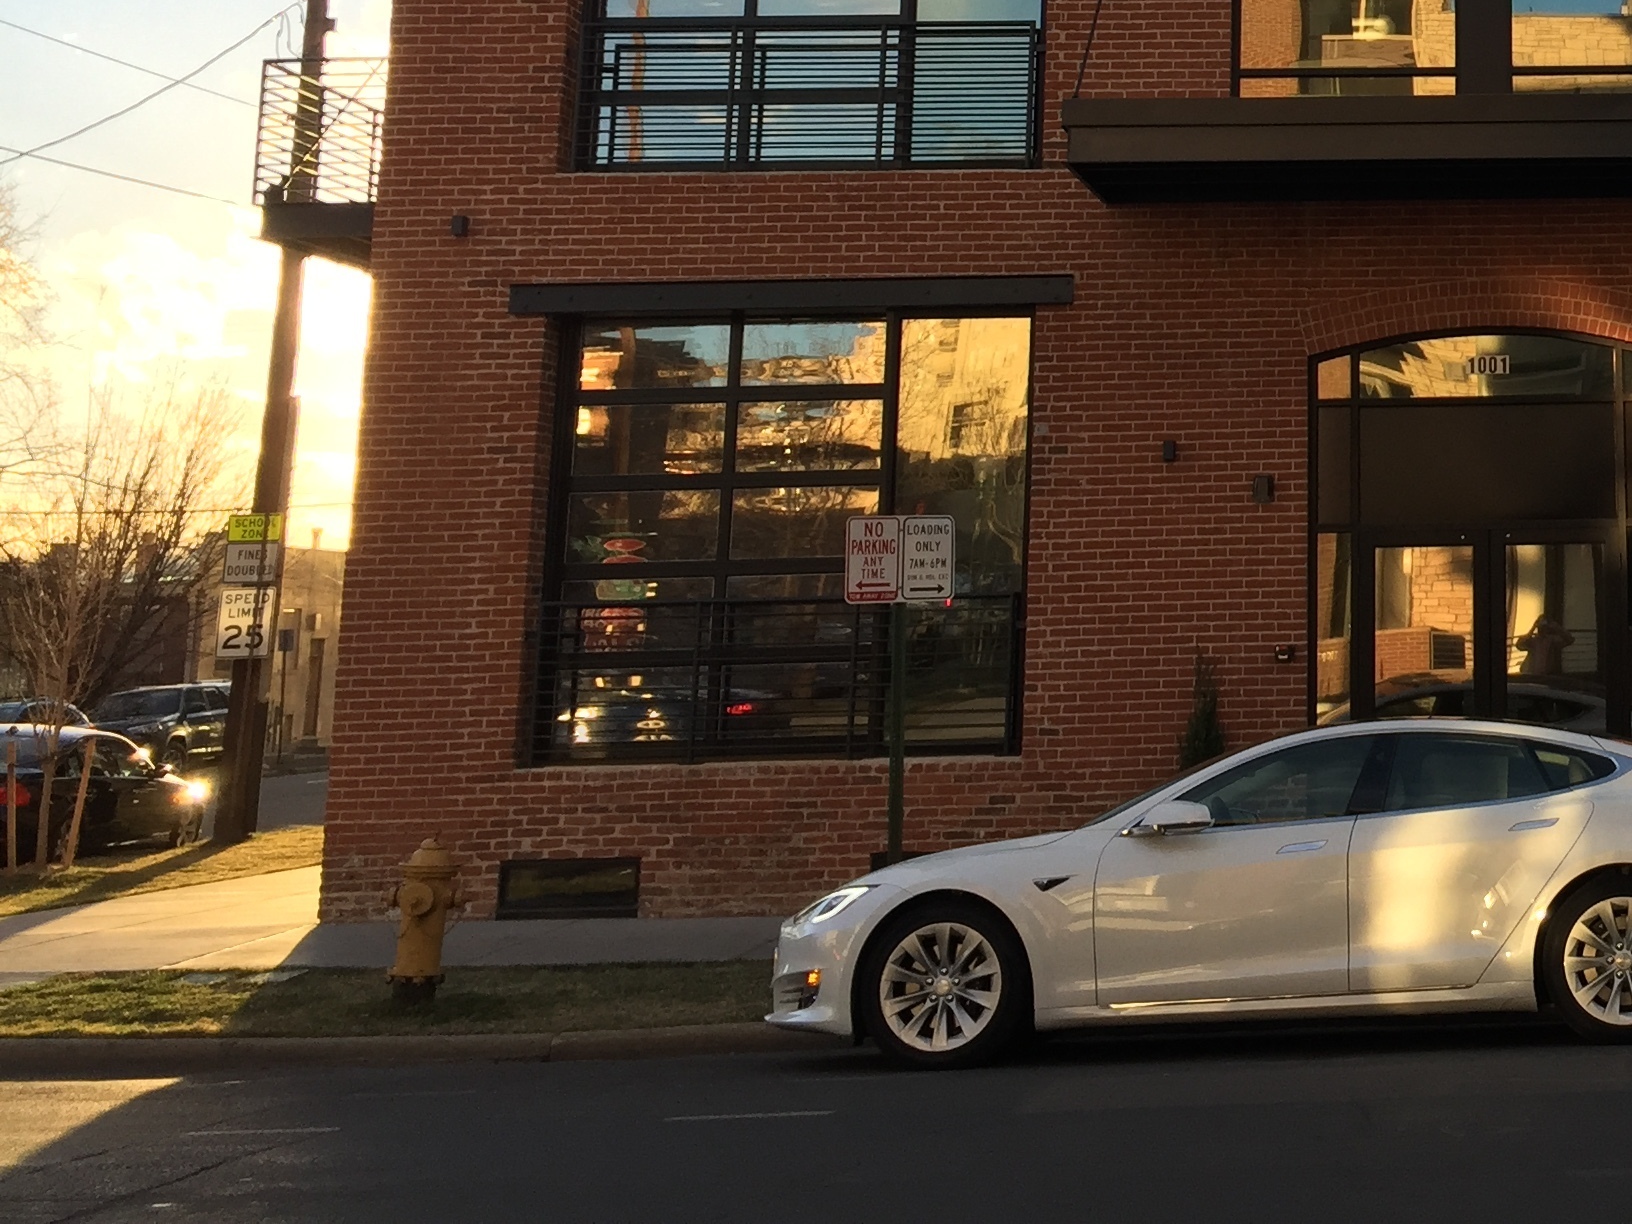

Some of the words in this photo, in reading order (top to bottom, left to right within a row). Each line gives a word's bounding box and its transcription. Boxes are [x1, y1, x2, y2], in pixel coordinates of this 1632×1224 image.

[1468, 356, 1507, 374] 1001
[235, 518, 277, 528] SCHOL
[864, 521, 884, 538] NO
[907, 524, 950, 536] LOADING
[851, 539, 896, 555] PARKING
[915, 541, 941, 552] ONLY
[238, 549, 267, 560] FINE
[862, 556, 884, 567] ANY
[861, 568, 886, 579] TIME
[222, 624, 263, 649] 25
